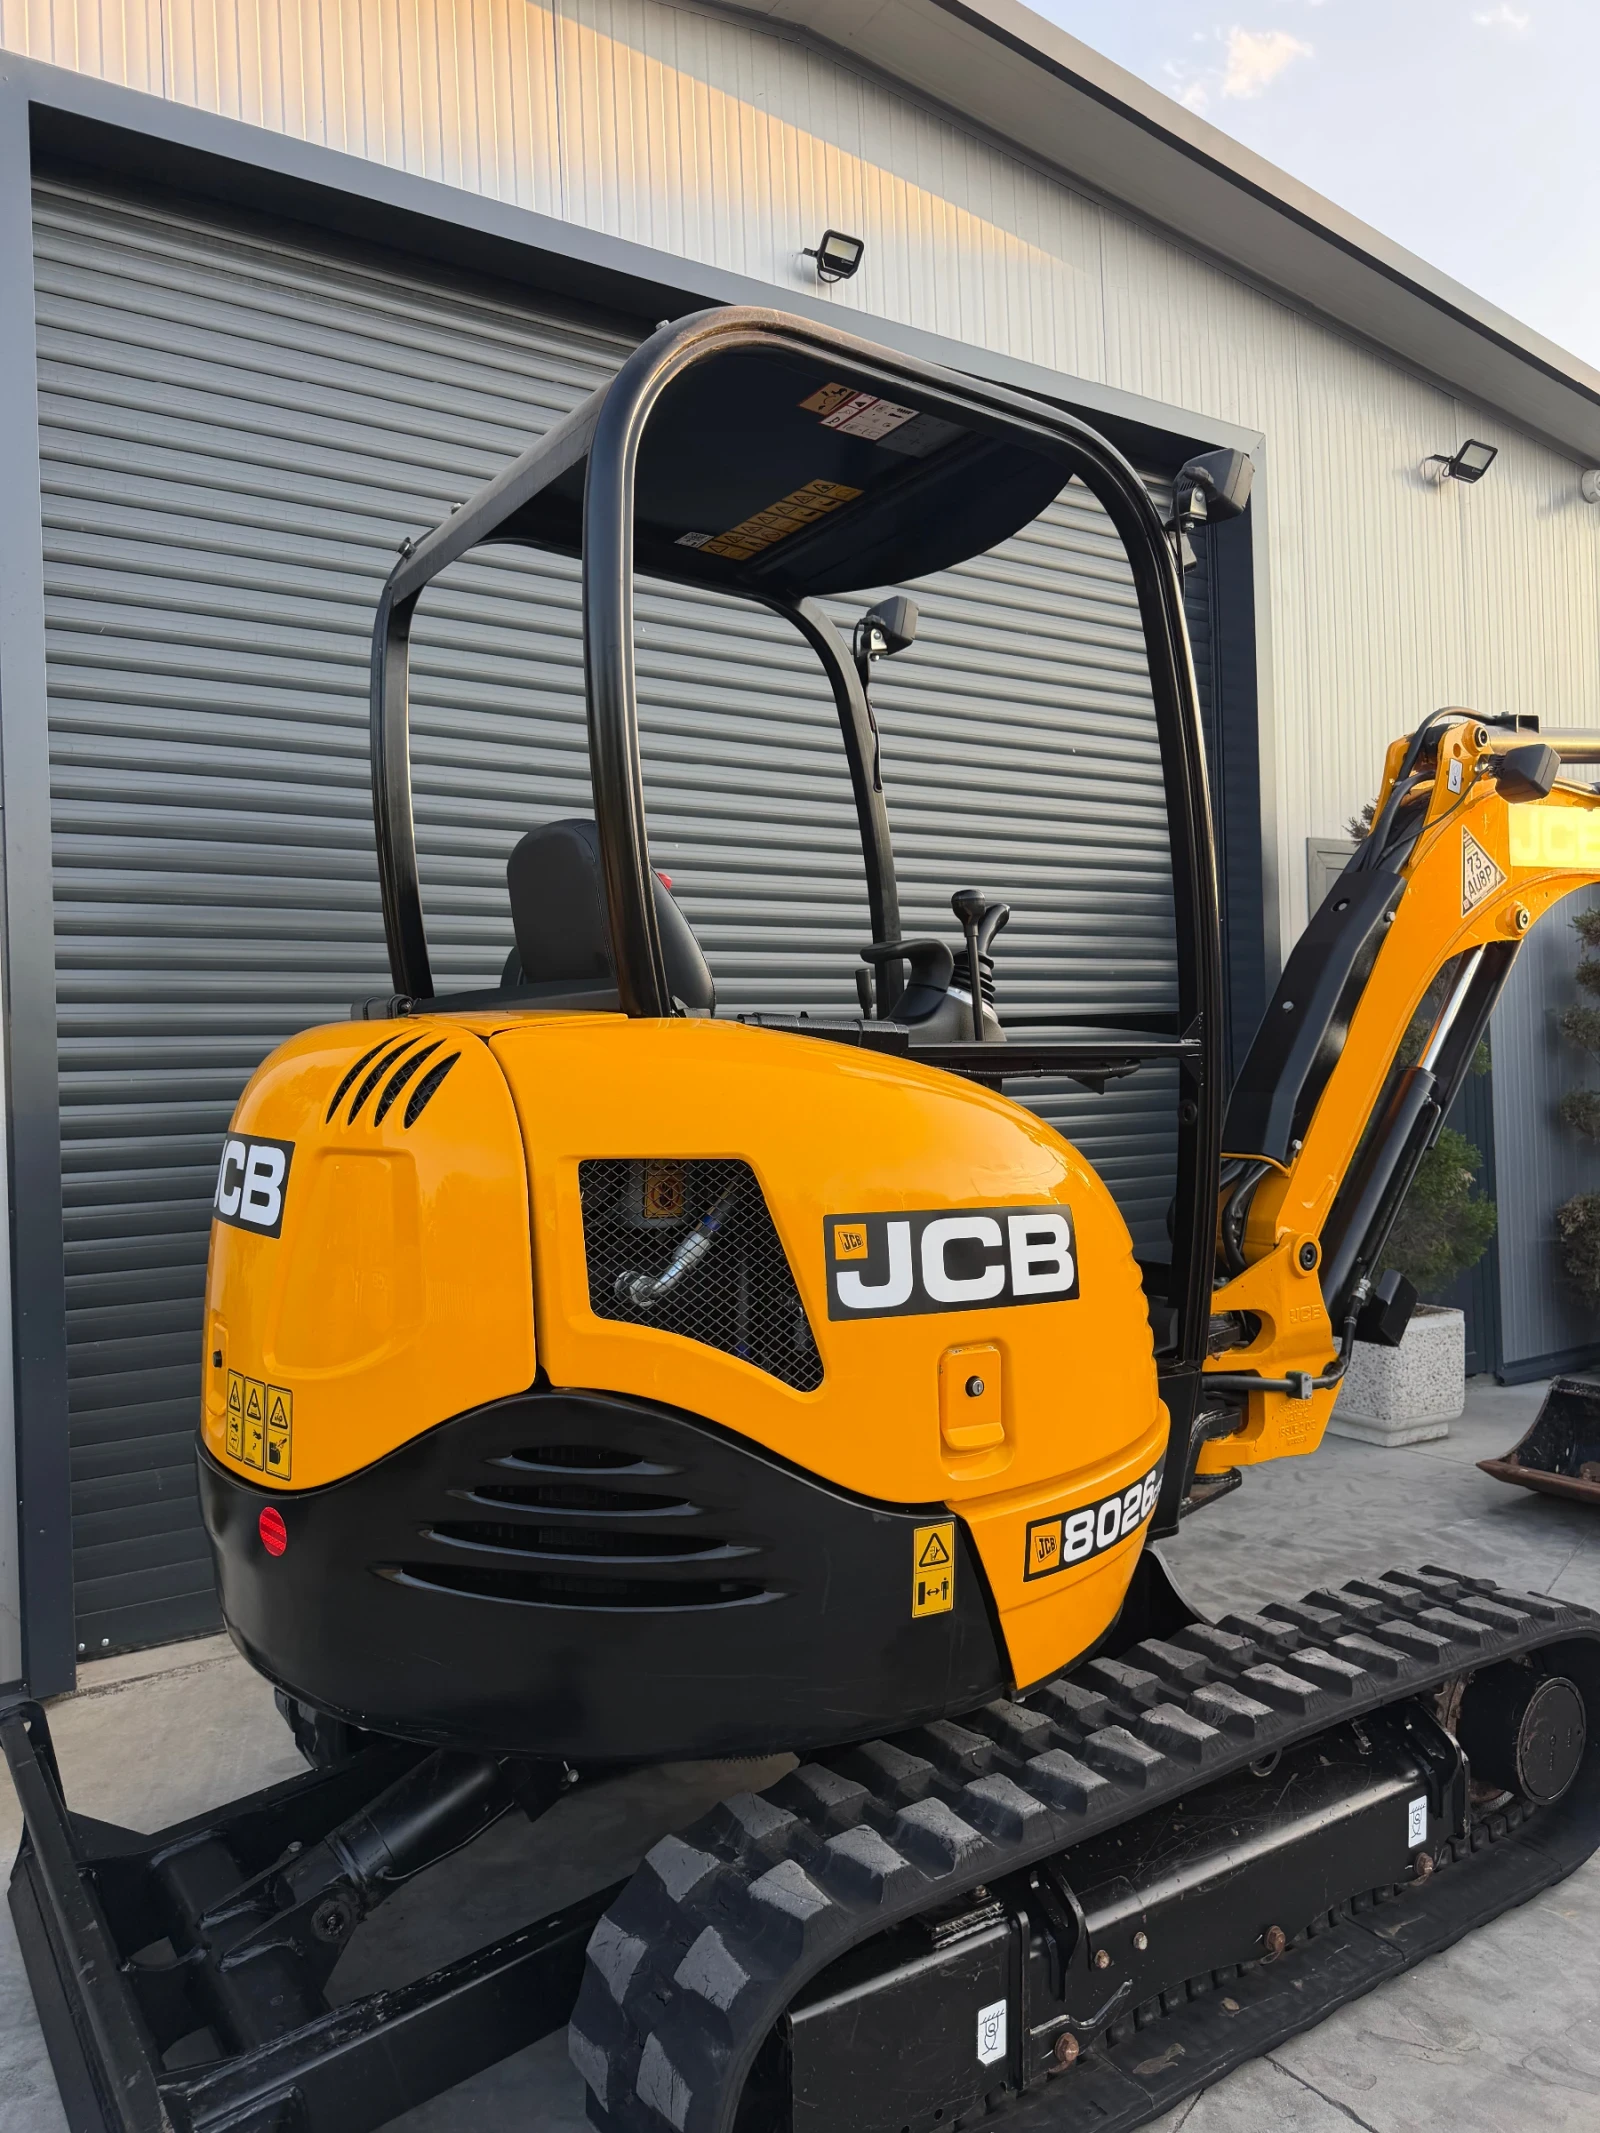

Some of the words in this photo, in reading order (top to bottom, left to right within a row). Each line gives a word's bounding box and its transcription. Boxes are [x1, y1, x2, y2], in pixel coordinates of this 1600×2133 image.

[1467, 851, 1482, 875] 73
[1468, 865, 1492, 899] AU8P
[213, 1139, 286, 1226] CB
[836, 1213, 1075, 1309] JCB
[843, 1234, 862, 1250] JCB
[1038, 1535, 1057, 1560] JCB
[1063, 1470, 1157, 1562] 8026
